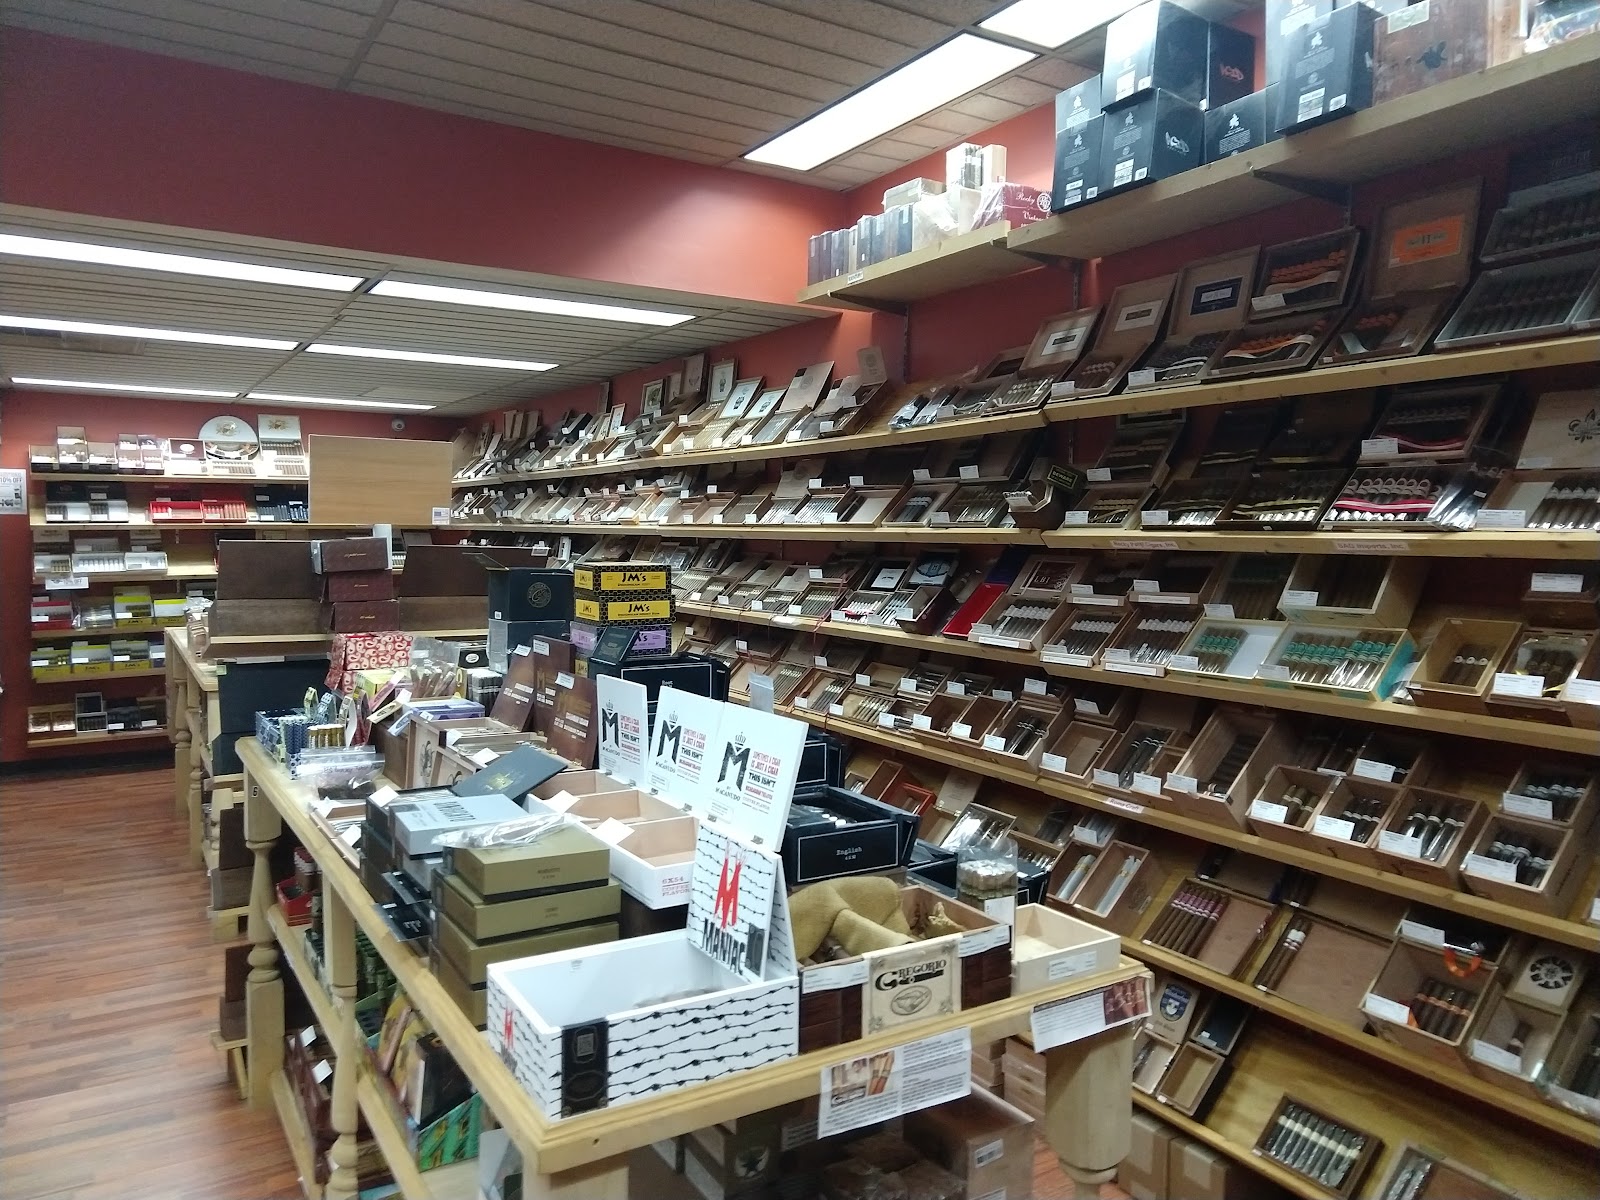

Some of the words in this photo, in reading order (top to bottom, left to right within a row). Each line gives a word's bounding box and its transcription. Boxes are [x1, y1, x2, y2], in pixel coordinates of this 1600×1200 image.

[621, 572, 647, 583] JM's
[628, 603, 650, 613] JM's
[601, 708, 620, 749] M
[656, 719, 682, 765] M
[681, 747, 691, 757] THIS
[717, 741, 751, 792] M
[748, 772, 761, 783] THIS
[761, 777, 776, 788] ISN'T
[836, 846, 863, 856] English
[875, 959, 947, 991] GREGORIO
